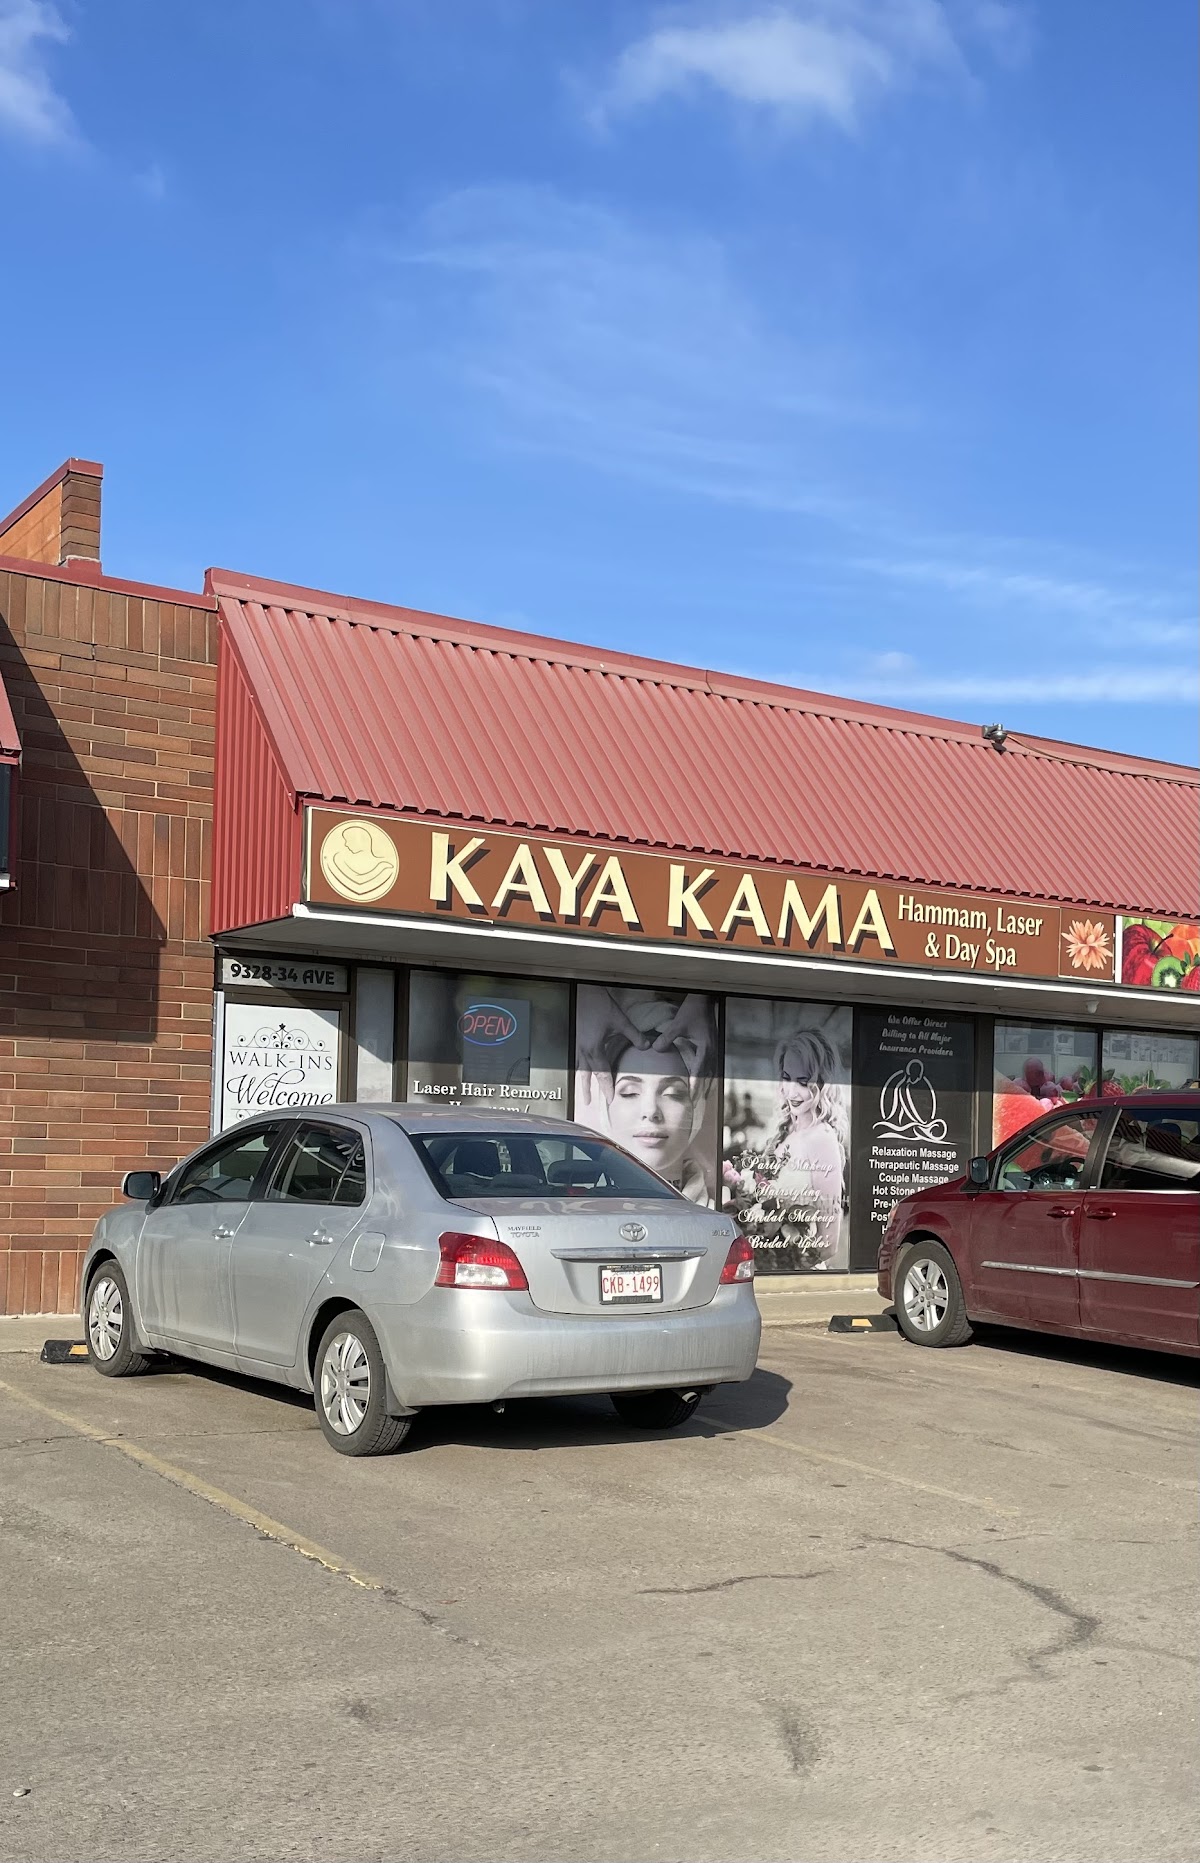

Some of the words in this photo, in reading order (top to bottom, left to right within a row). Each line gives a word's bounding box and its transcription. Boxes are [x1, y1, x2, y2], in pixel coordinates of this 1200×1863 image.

[429, 831, 640, 926] KAYA
[667, 865, 894, 951] KAMA
[898, 894, 992, 936] Hammam,
[997, 907, 1043, 936] Laser
[924, 932, 940, 958] &
[945, 933, 980, 968] Day
[985, 938, 1017, 970] Spa
[230, 963, 298, 983] 9328-34
[302, 969, 335, 986] AVE
[459, 1014, 512, 1036] OPEN
[887, 1015, 900, 1024] We
[902, 1016, 922, 1026] Offer
[923, 1018, 948, 1028] Direct
[882, 1028, 907, 1042] Billing
[909, 1032, 917, 1040] to
[918, 1031, 930, 1041] All
[930, 1032, 952, 1045] Major
[879, 1042, 917, 1054] Insurance
[918, 1045, 954, 1056] Providers
[229, 1051, 333, 1070] WALK-INS
[226, 1068, 333, 1107] Welcome
[413, 1080, 457, 1096] Laser
[461, 1083, 495, 1097] Hair
[500, 1085, 562, 1100] Removal
[872, 1146, 918, 1157] Relaxation
[920, 1148, 957, 1160] Massage
[741, 1156, 781, 1175] Party
[789, 1160, 834, 1178] Makeup
[869, 1159, 920, 1171] Therapeutic
[922, 1161, 959, 1173] Massage
[879, 1173, 910, 1184] Couple
[911, 1174, 949, 1185] Massage
[755, 1181, 821, 1202] Hairstyling
[872, 1185, 888, 1196] Hot
[890, 1185, 916, 1196] Stone
[738, 1208, 786, 1223] Bridal
[788, 1209, 837, 1229] Makeup
[748, 1235, 791, 1249] Bridal
[602, 1275, 660, 1294] CKB-1499
